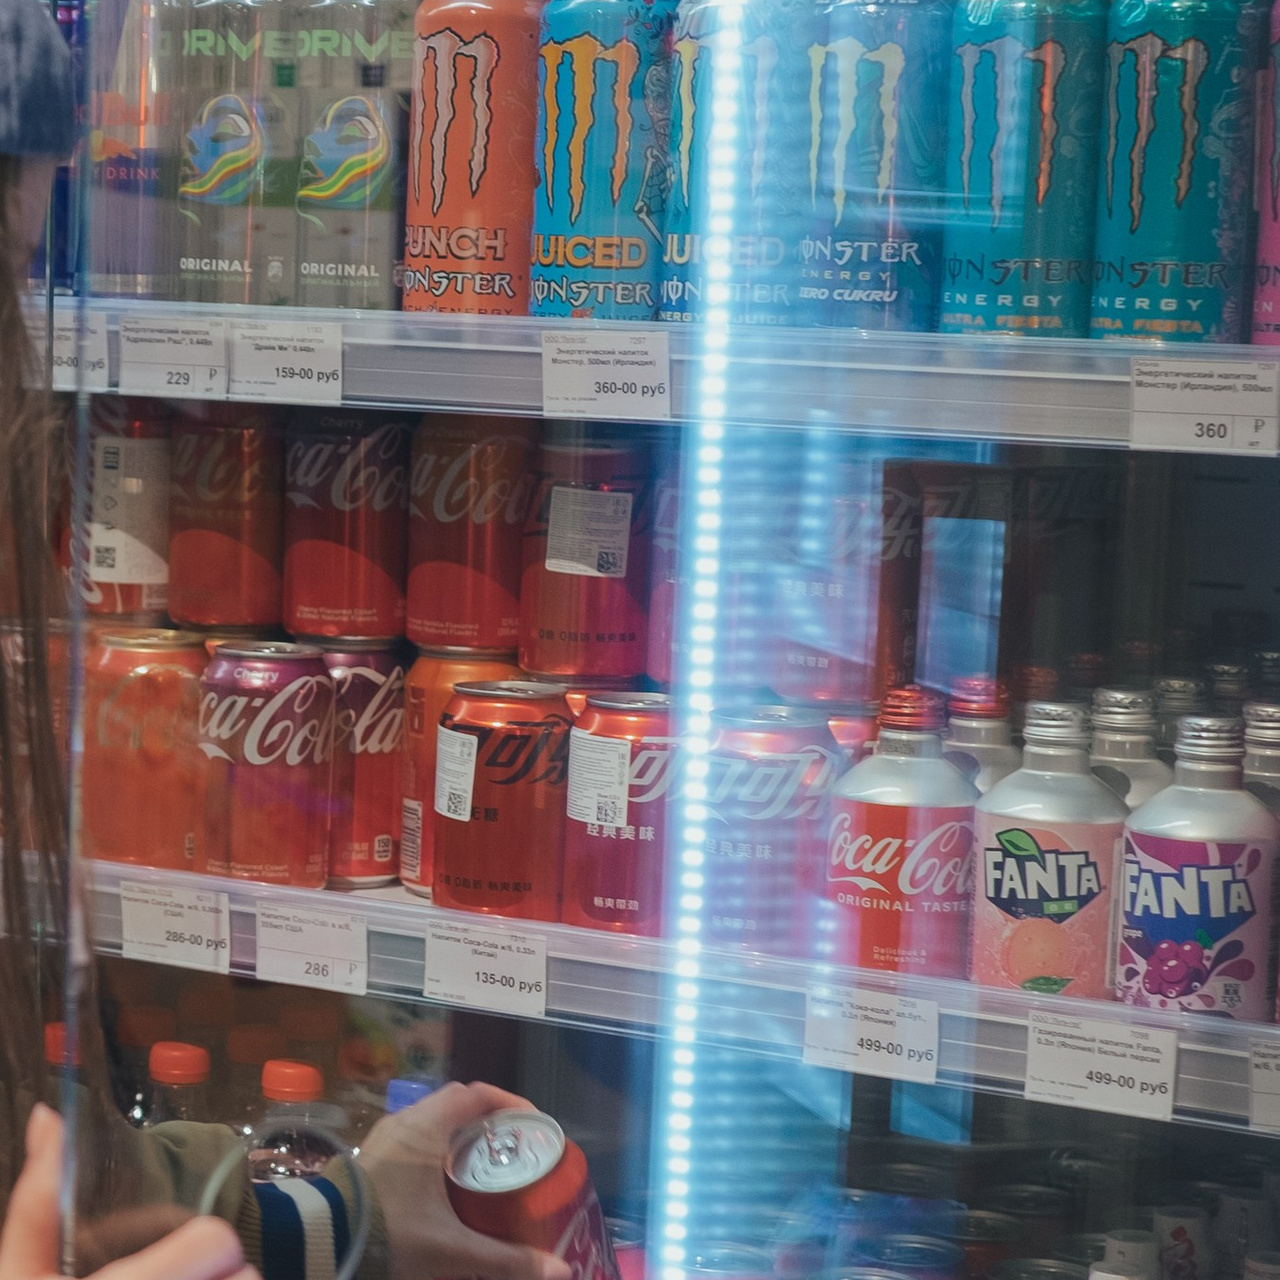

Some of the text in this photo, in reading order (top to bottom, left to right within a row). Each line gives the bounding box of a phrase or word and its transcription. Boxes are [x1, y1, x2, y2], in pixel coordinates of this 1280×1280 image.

[106, 167, 162, 180] DRINK
[531, 234, 648, 269] JUICED
[179, 257, 252, 274] ORIGINAL
[300, 262, 380, 278] ORIGINAL
[404, 270, 515, 300] ONSTER
[832, 287, 898, 303] CUKRU
[943, 291, 1064, 309] ENERGY
[1091, 294, 1205, 312] ENERGY
[556, 347, 616, 356] Энергетический
[84, 358, 105, 370] руб
[613, 358, 656, 368] (Ирландия)
[167, 372, 190, 386] 229
[275, 367, 340, 382] 159-00 руб
[1135, 368, 1258, 381] Энергетический напиток
[594, 381, 666, 397] 360-00 руб
[1135, 379, 1178, 390] Монстер
[1194, 422, 1228, 439] 360
[233, 667, 279, 684] Cherry
[586, 822, 656, 842] 经典美味
[985, 850, 1100, 900] FANTA
[1124, 860, 1253, 919] FANTA
[836, 892, 969, 914] ORIGINAL TASTE
[165, 930, 227, 951] 286-00 руб
[431, 932, 499, 950] Напиток Coca-Cola
[873, 945, 916, 957] Delicious
[873, 953, 927, 965] Refreshing
[304, 961, 330, 978] 286
[475, 971, 543, 995] 135-00 руб
[1032, 1026, 1097, 1044] Газированный
[1099, 1036, 1134, 1051] напиток
[856, 1036, 934, 1063] 499-00 руб
[1056, 1039, 1161, 1065] (Япония) Белый персик
[1085, 1070, 1170, 1097] 499-00 руб
